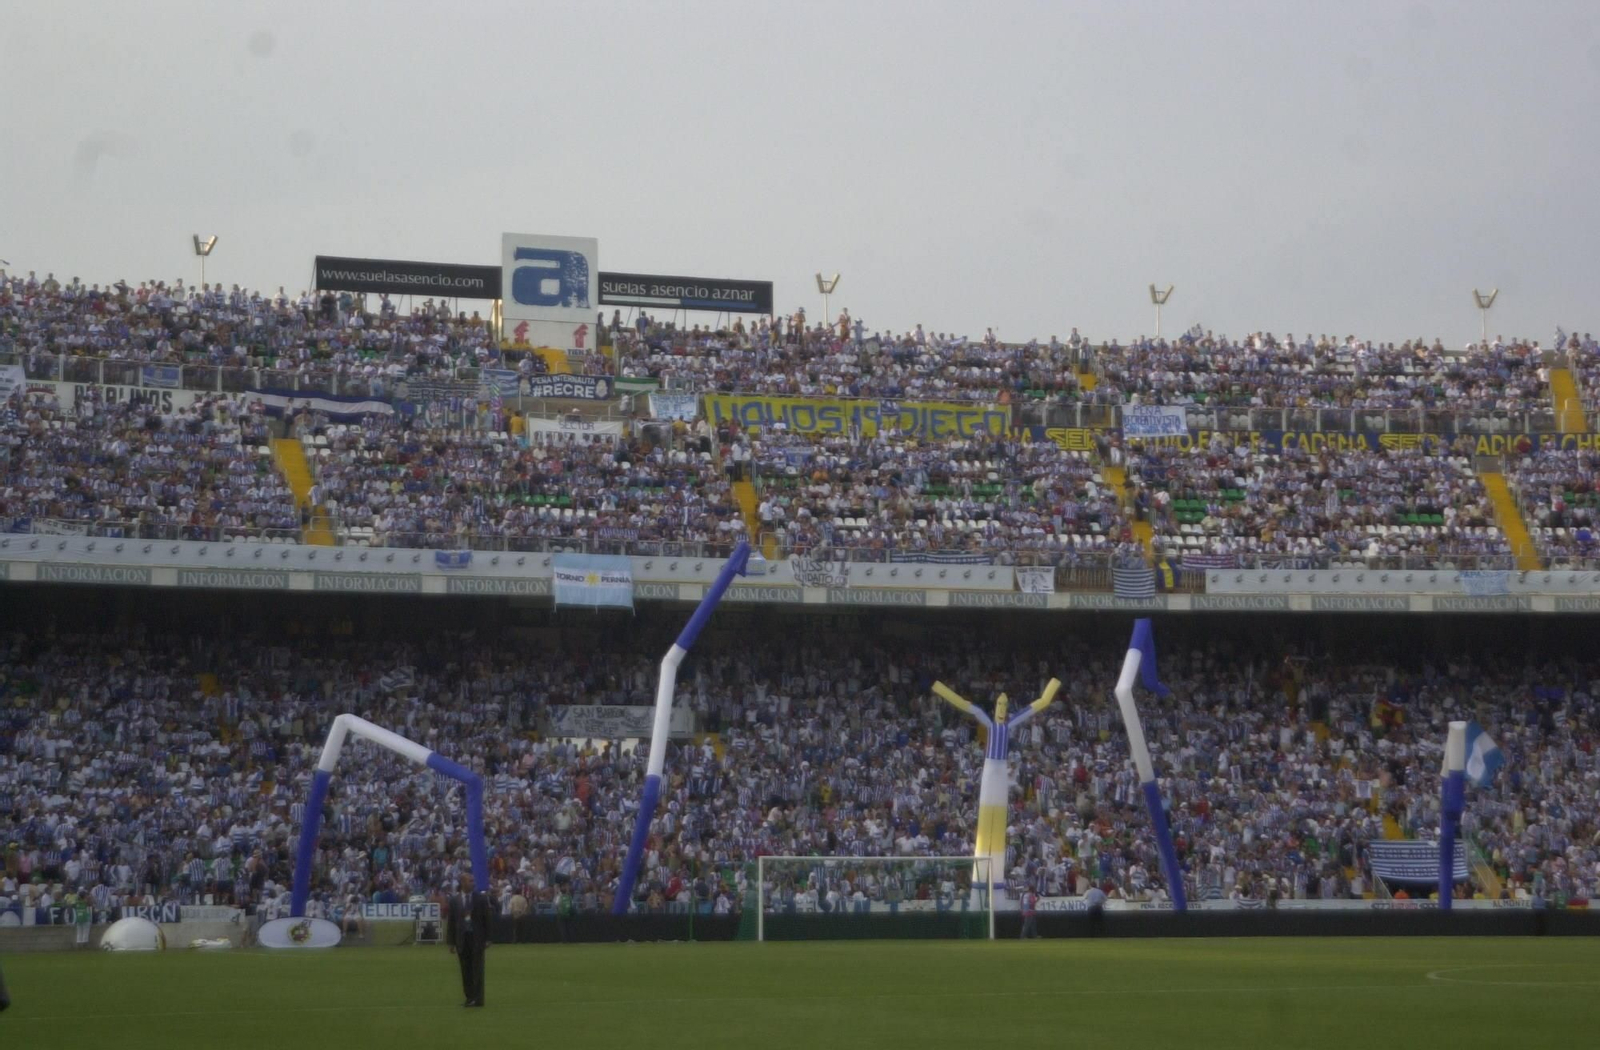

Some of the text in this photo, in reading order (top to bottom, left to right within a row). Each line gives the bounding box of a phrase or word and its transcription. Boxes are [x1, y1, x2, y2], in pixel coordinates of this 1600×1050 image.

[321, 269, 484, 288] www.suelasasencio.com
[602, 281, 755, 301] suelas asencio aznar
[533, 383, 595, 398] #RECRE
[40, 566, 147, 582] INFORMACION
[182, 571, 285, 588] INFORMACION
[318, 575, 420, 591] INFORMACION
[451, 578, 549, 594] INFORMACION
[831, 590, 922, 604] INFORMACION
[953, 592, 1043, 607] INFORMACION
[1193, 596, 1284, 610] INFORMACION
[1314, 597, 1405, 610] INFORMACION
[1436, 597, 1527, 611] INFORMACION
